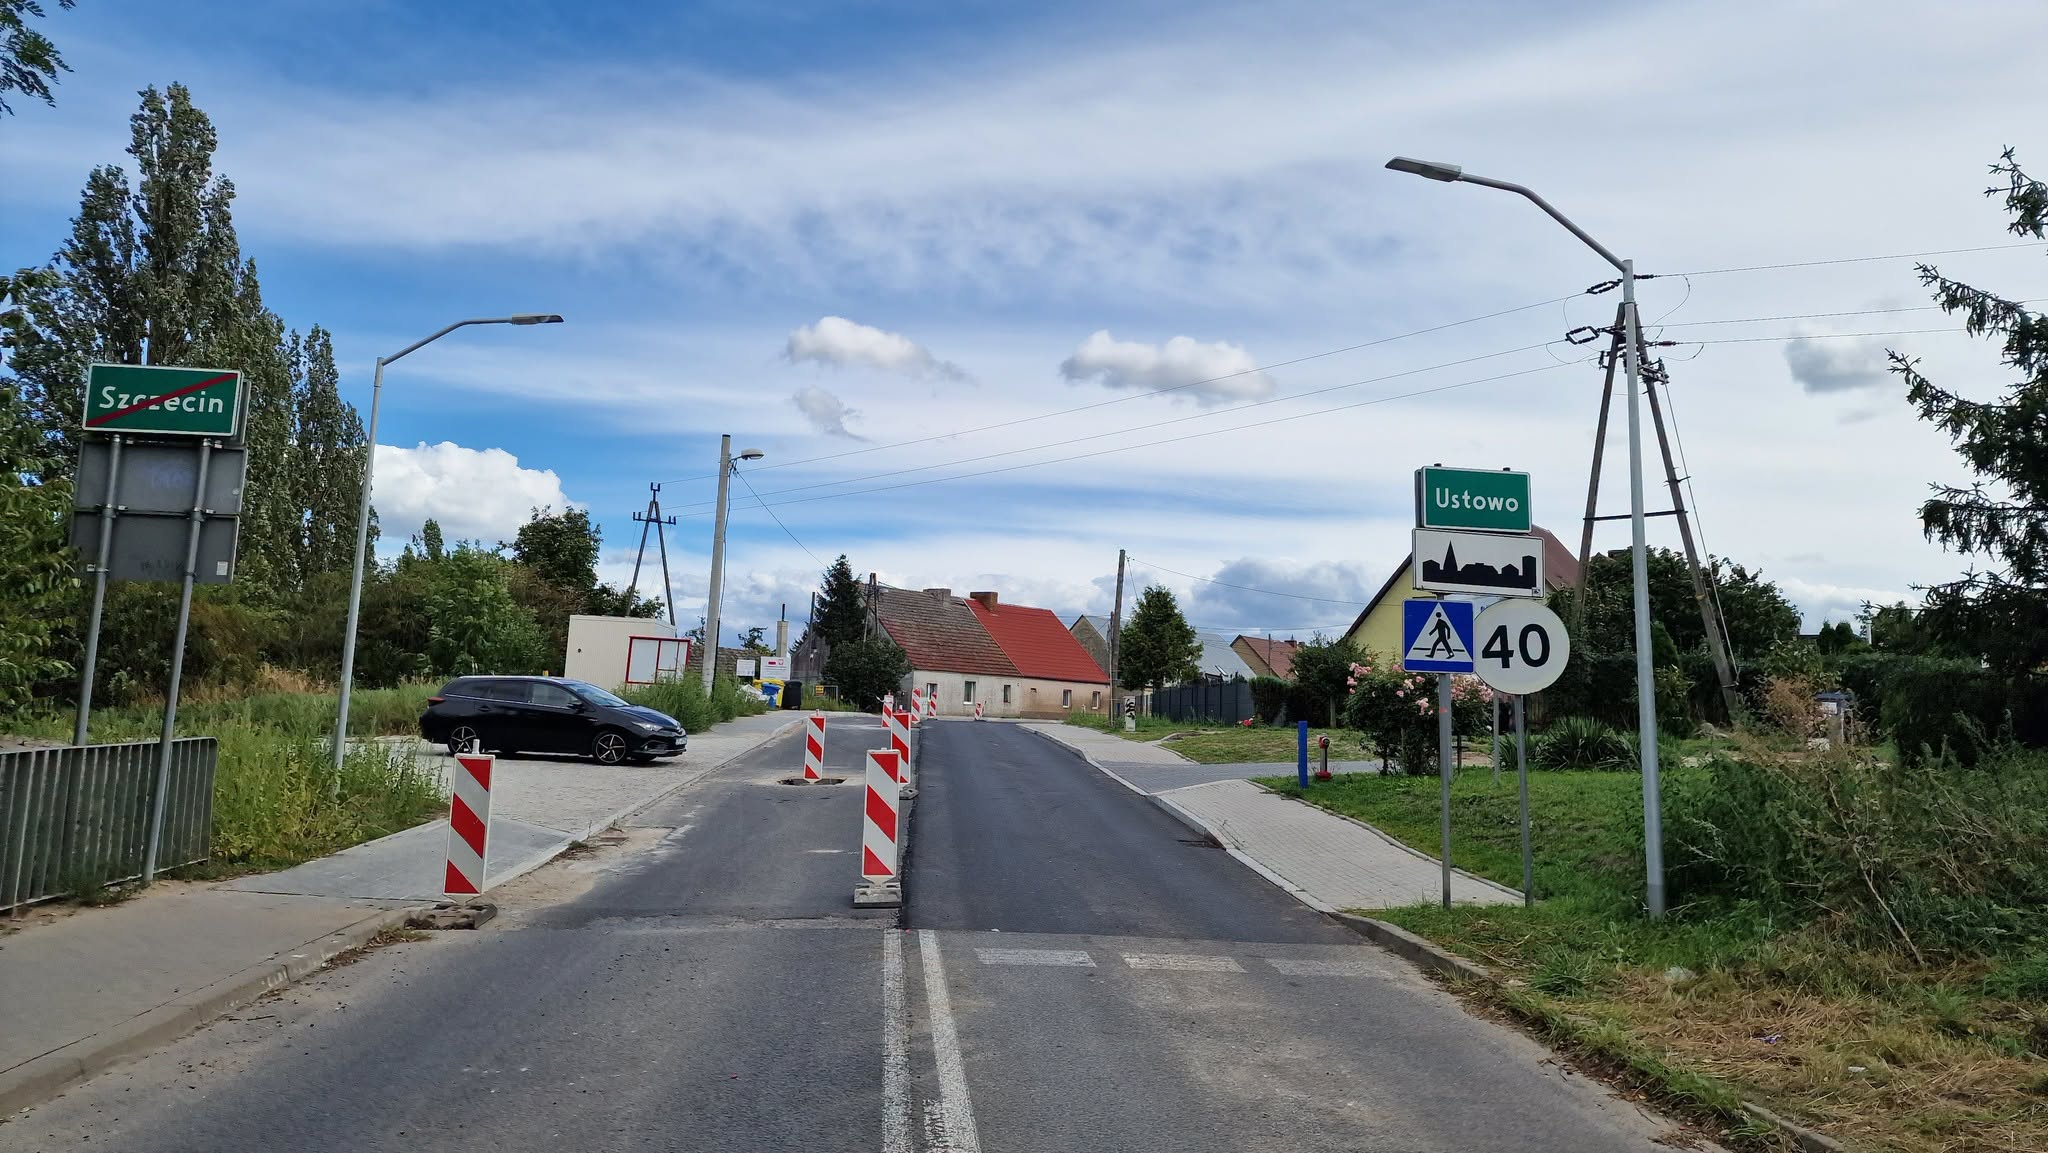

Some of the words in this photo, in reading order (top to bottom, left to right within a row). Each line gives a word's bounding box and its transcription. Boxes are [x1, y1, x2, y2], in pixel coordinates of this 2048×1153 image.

[99, 385, 223, 413] Szczecin
[1435, 487, 1519, 512] Ustowo
[1481, 623, 1550, 669] 40
